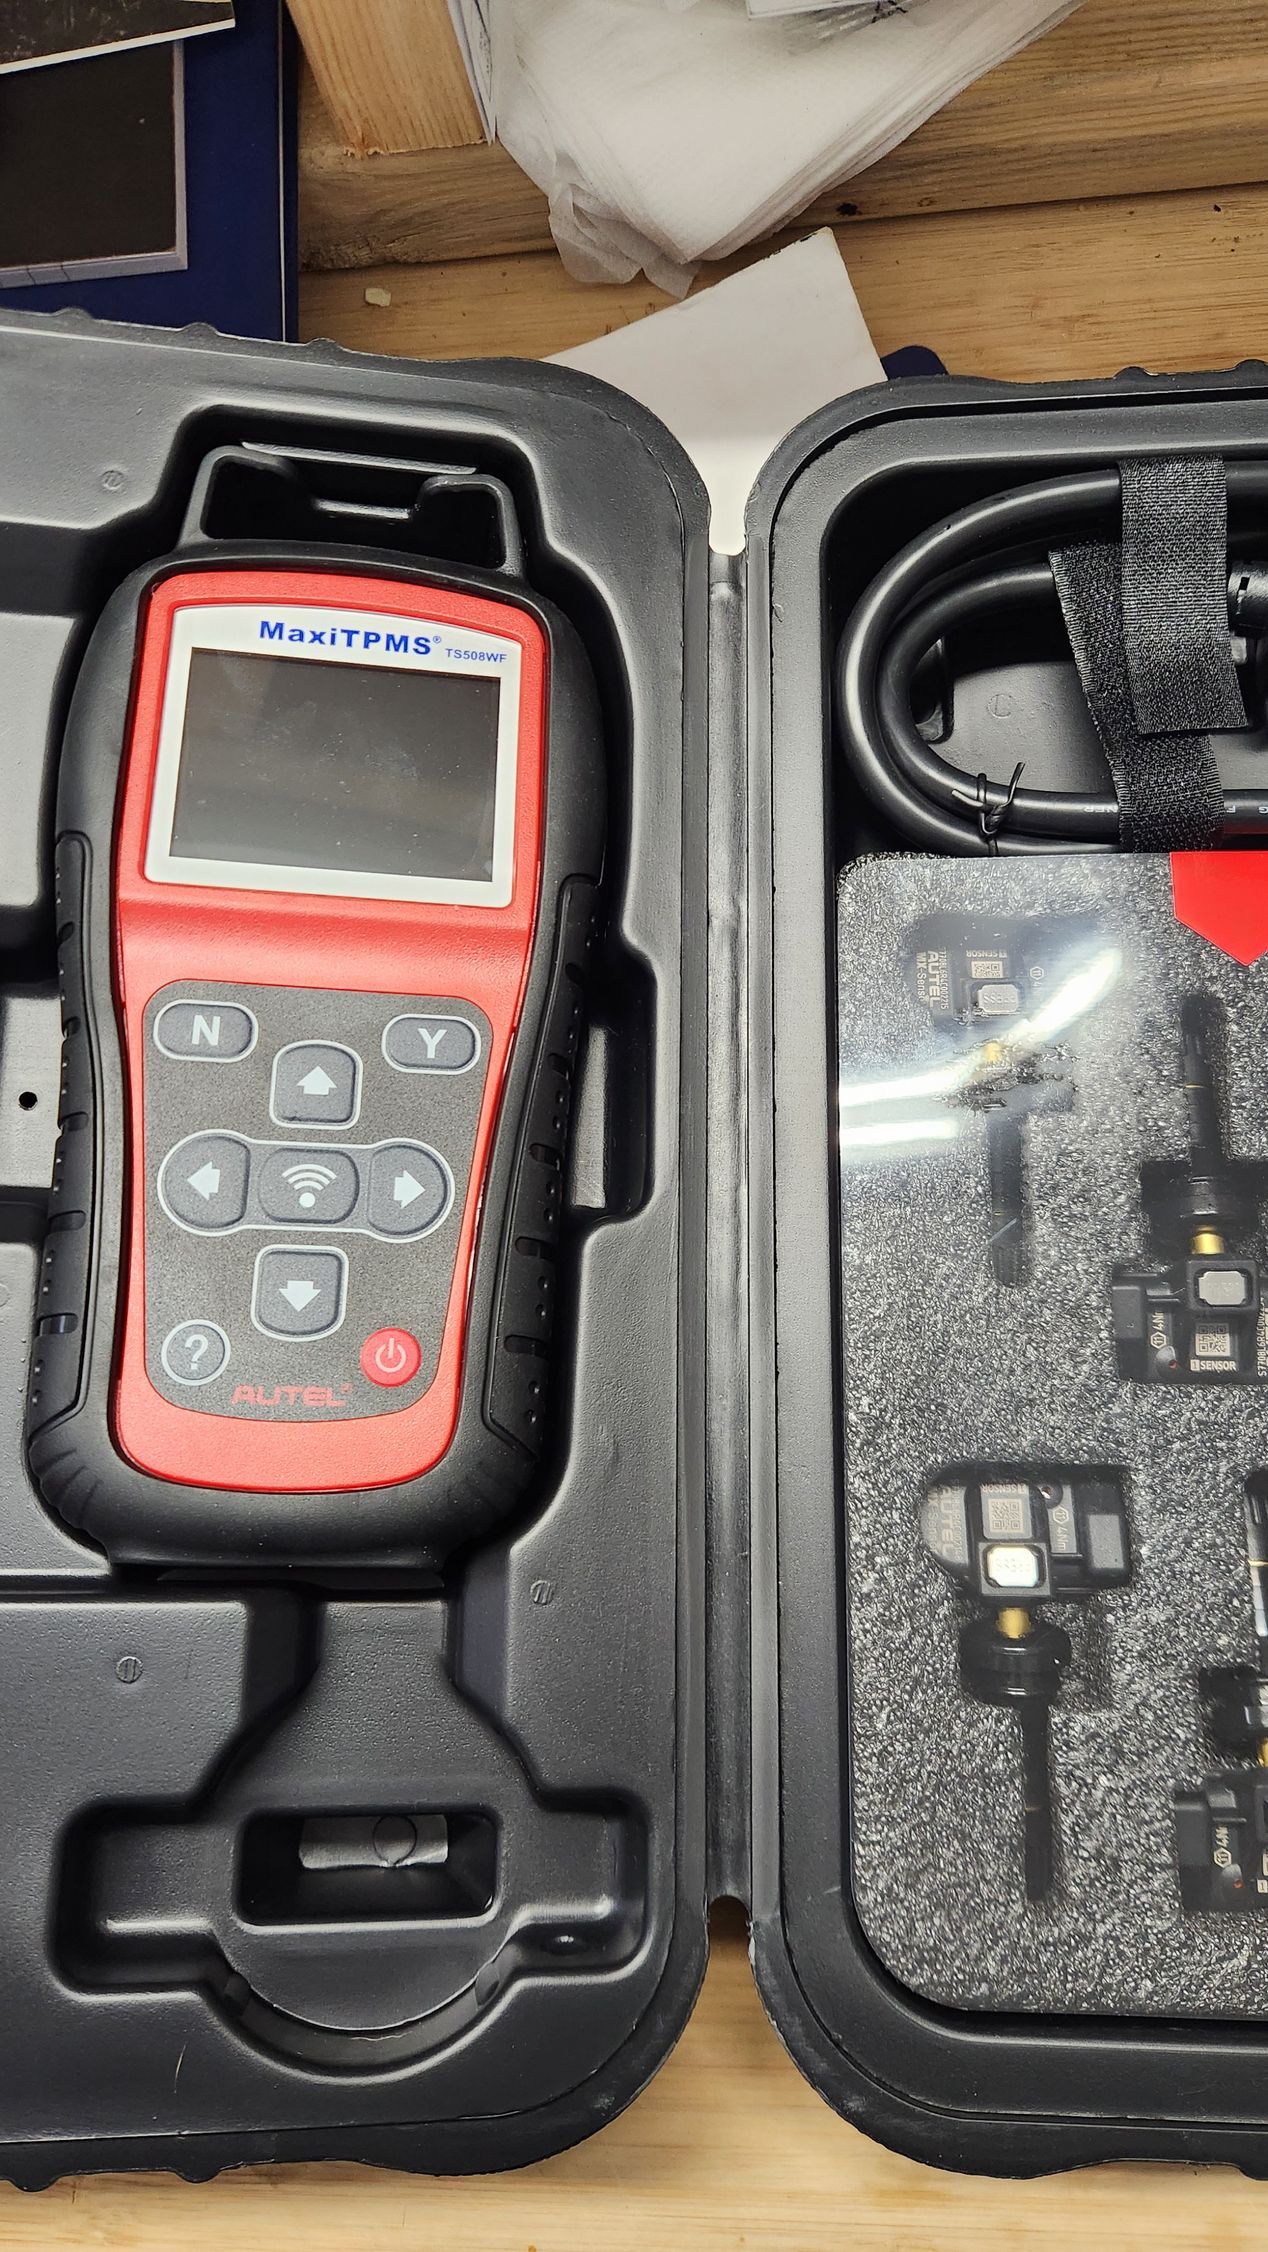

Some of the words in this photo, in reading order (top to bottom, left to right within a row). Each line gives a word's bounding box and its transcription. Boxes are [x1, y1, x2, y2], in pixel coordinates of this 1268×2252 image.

[445, 648, 507, 663] TS508WF
[928, 950, 941, 1008] AUTEL
[191, 1014, 221, 1046] N
[417, 1028, 449, 1059] Y
[1200, 1361, 1238, 1372] SENSOR
[230, 1384, 346, 1407] AUTEL
